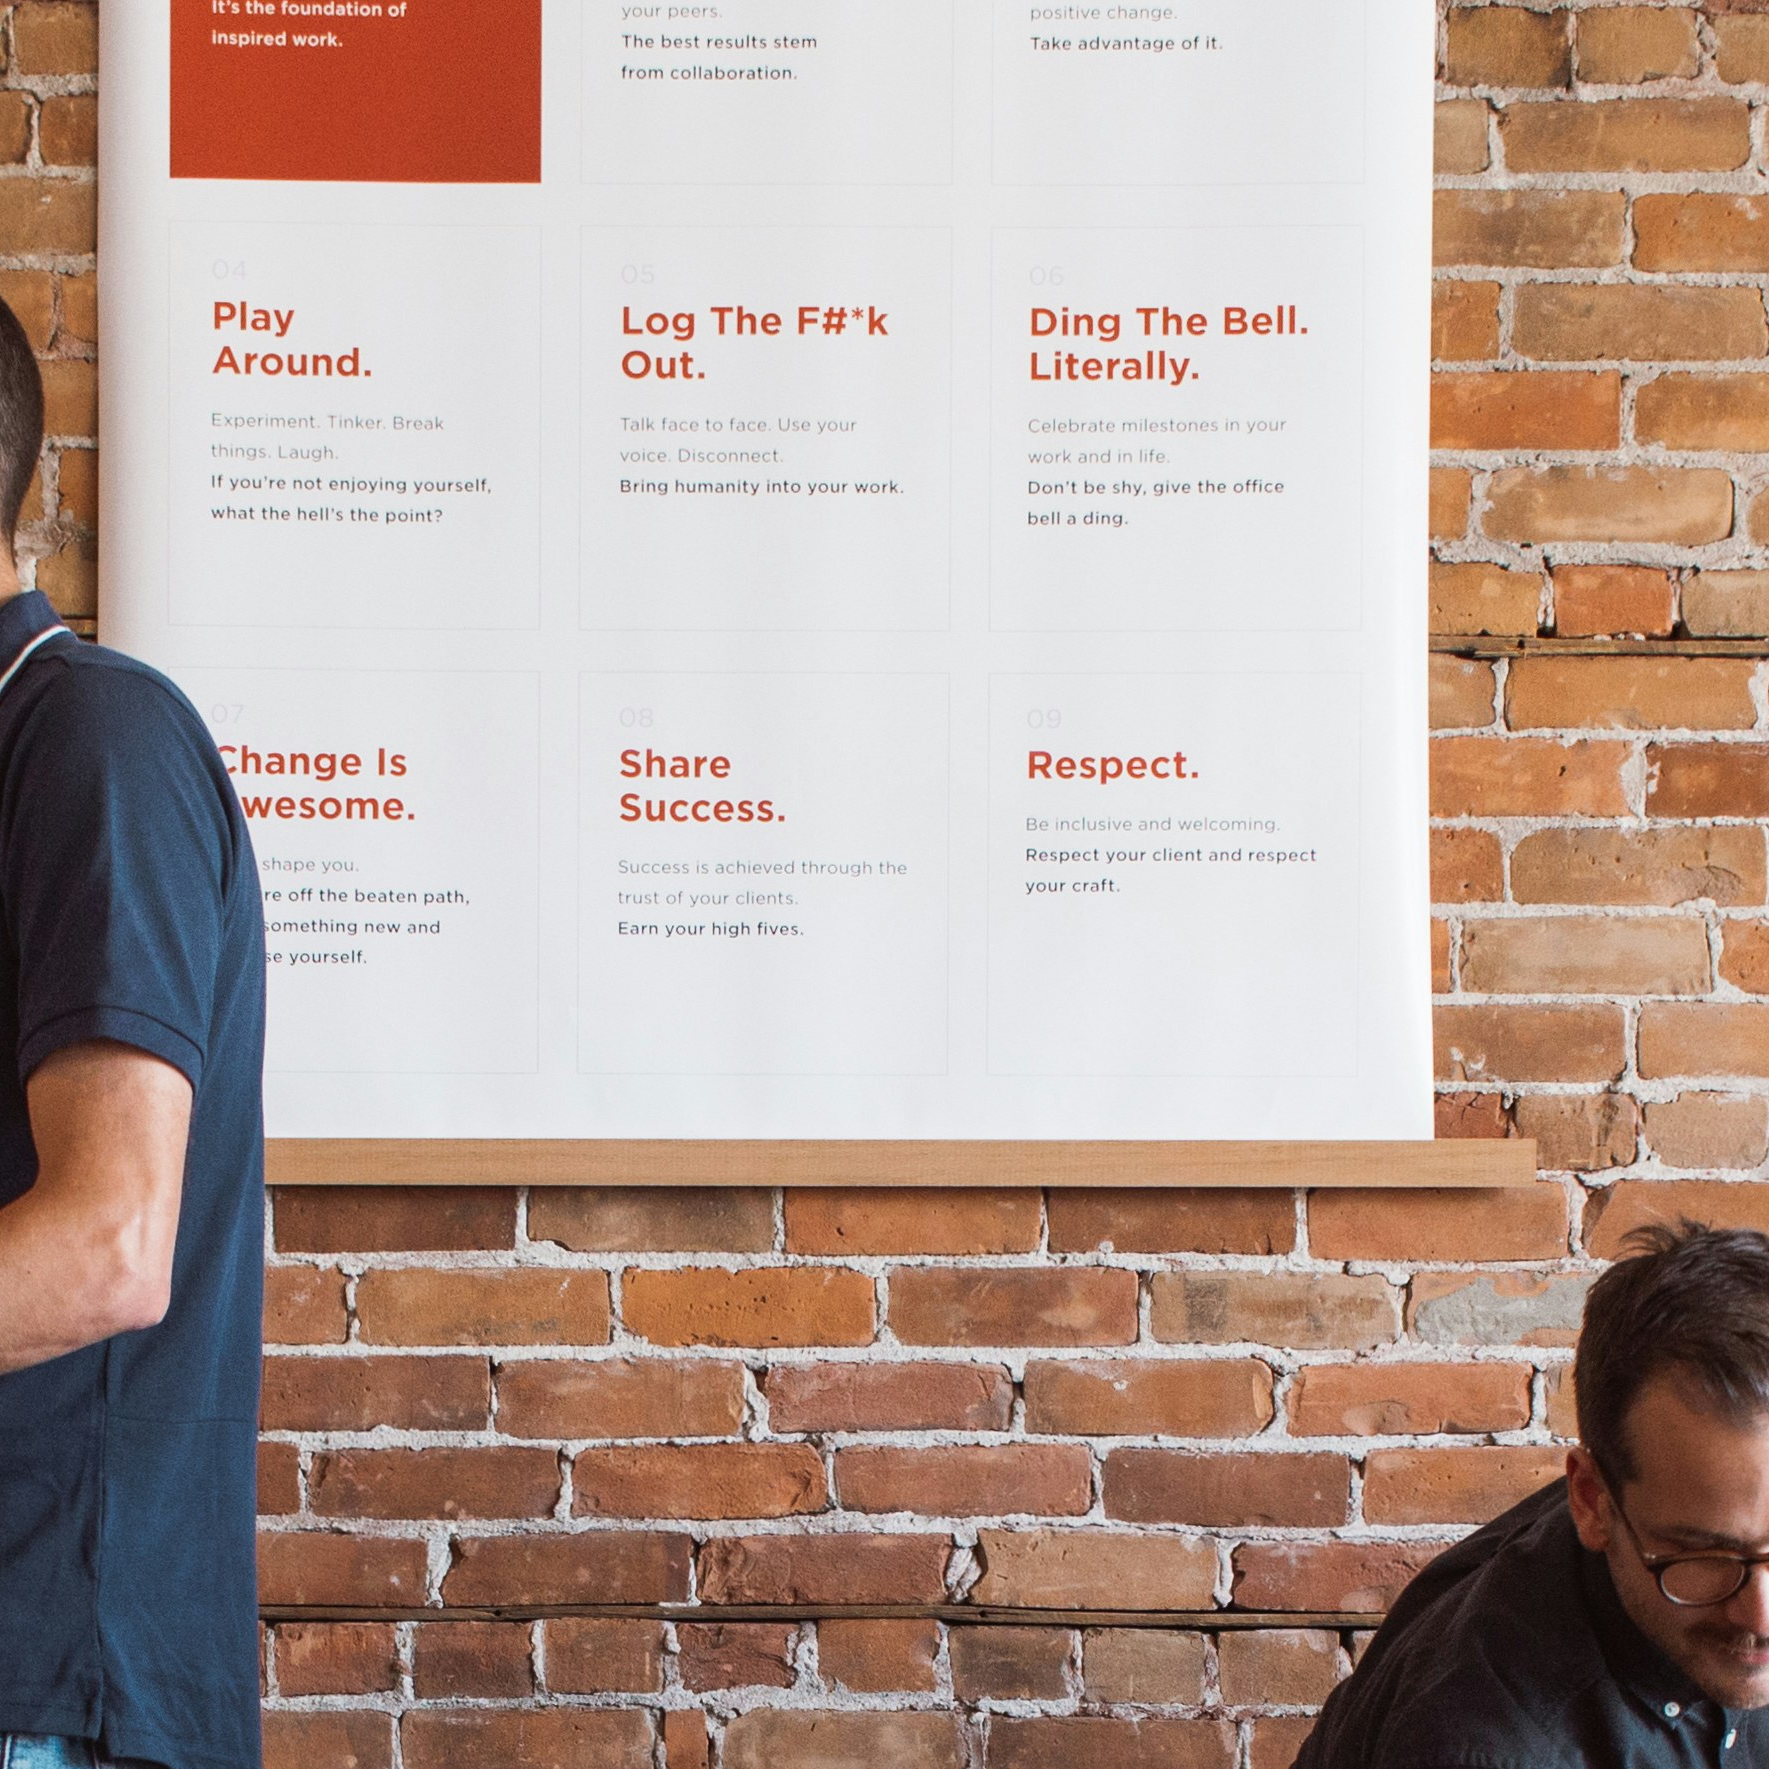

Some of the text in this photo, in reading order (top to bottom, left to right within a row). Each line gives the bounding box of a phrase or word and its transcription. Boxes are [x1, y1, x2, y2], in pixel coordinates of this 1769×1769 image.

[212, 0, 407, 18] It's the foundation of
[621, 6, 722, 21] your peers.
[1030, 5, 1178, 22] positive change.
[211, 29, 343, 48] inspired work.
[622, 34, 818, 50] The best results stem
[1030, 35, 1223, 53] Take advantage of it.
[621, 65, 798, 81] from collaboration.
[212, 258, 247, 280] 04
[620, 264, 655, 285] 05
[1029, 265, 1065, 287] 06
[213, 300, 295, 338] Play
[622, 306, 695, 342] Log
[710, 305, 782, 336] The
[1030, 304, 1308, 343] Ding The Bell.
[212, 345, 372, 377] Around.
[621, 349, 705, 380] Out.
[1030, 350, 1199, 386] Literally.
[211, 412, 444, 431] Experiment. Tinker. Break
[620, 416, 856, 435] Talk face to face. Use your
[1027, 418, 1286, 434] Celebrate milestones in your
[211, 444, 339, 463] things. Laugh.
[619, 448, 784, 463] voice. Disconnect.
[1027, 448, 1170, 464] work and in life.
[211, 474, 491, 495] If you're not enjoying yourself,
[619, 479, 904, 497] Bring humanity into your work.
[1027, 479, 1285, 497] Don't be shy, give the office
[211, 505, 443, 525] what the hell's the point?
[1027, 511, 1128, 528] bell a ding.
[210, 703, 245, 724] 07
[618, 706, 654, 728] 08
[1027, 708, 1062, 730] 09
[217, 744, 407, 781] Change Is
[620, 748, 731, 779] Share
[1028, 750, 1199, 785] Respect.
[241, 795, 416, 821] wesome.
[620, 792, 786, 823] Success.
[1025, 816, 1281, 833] Be inclusive and welcoming.
[1025, 847, 1316, 865] Respect your client and respect
[262, 857, 360, 875] shape you.
[618, 859, 908, 877] Success is achieved through the
[287, 887, 313, 903] off
[318, 888, 349, 903] the
[354, 888, 418, 903] beaten
[423, 889, 470, 906] path,
[1025, 878, 1120, 896] your craft.
[617, 890, 799, 908] trust of your clients.
[263, 918, 441, 936] something new and
[618, 921, 804, 939] Earn your high fives.
[289, 949, 367, 967] yourself.
